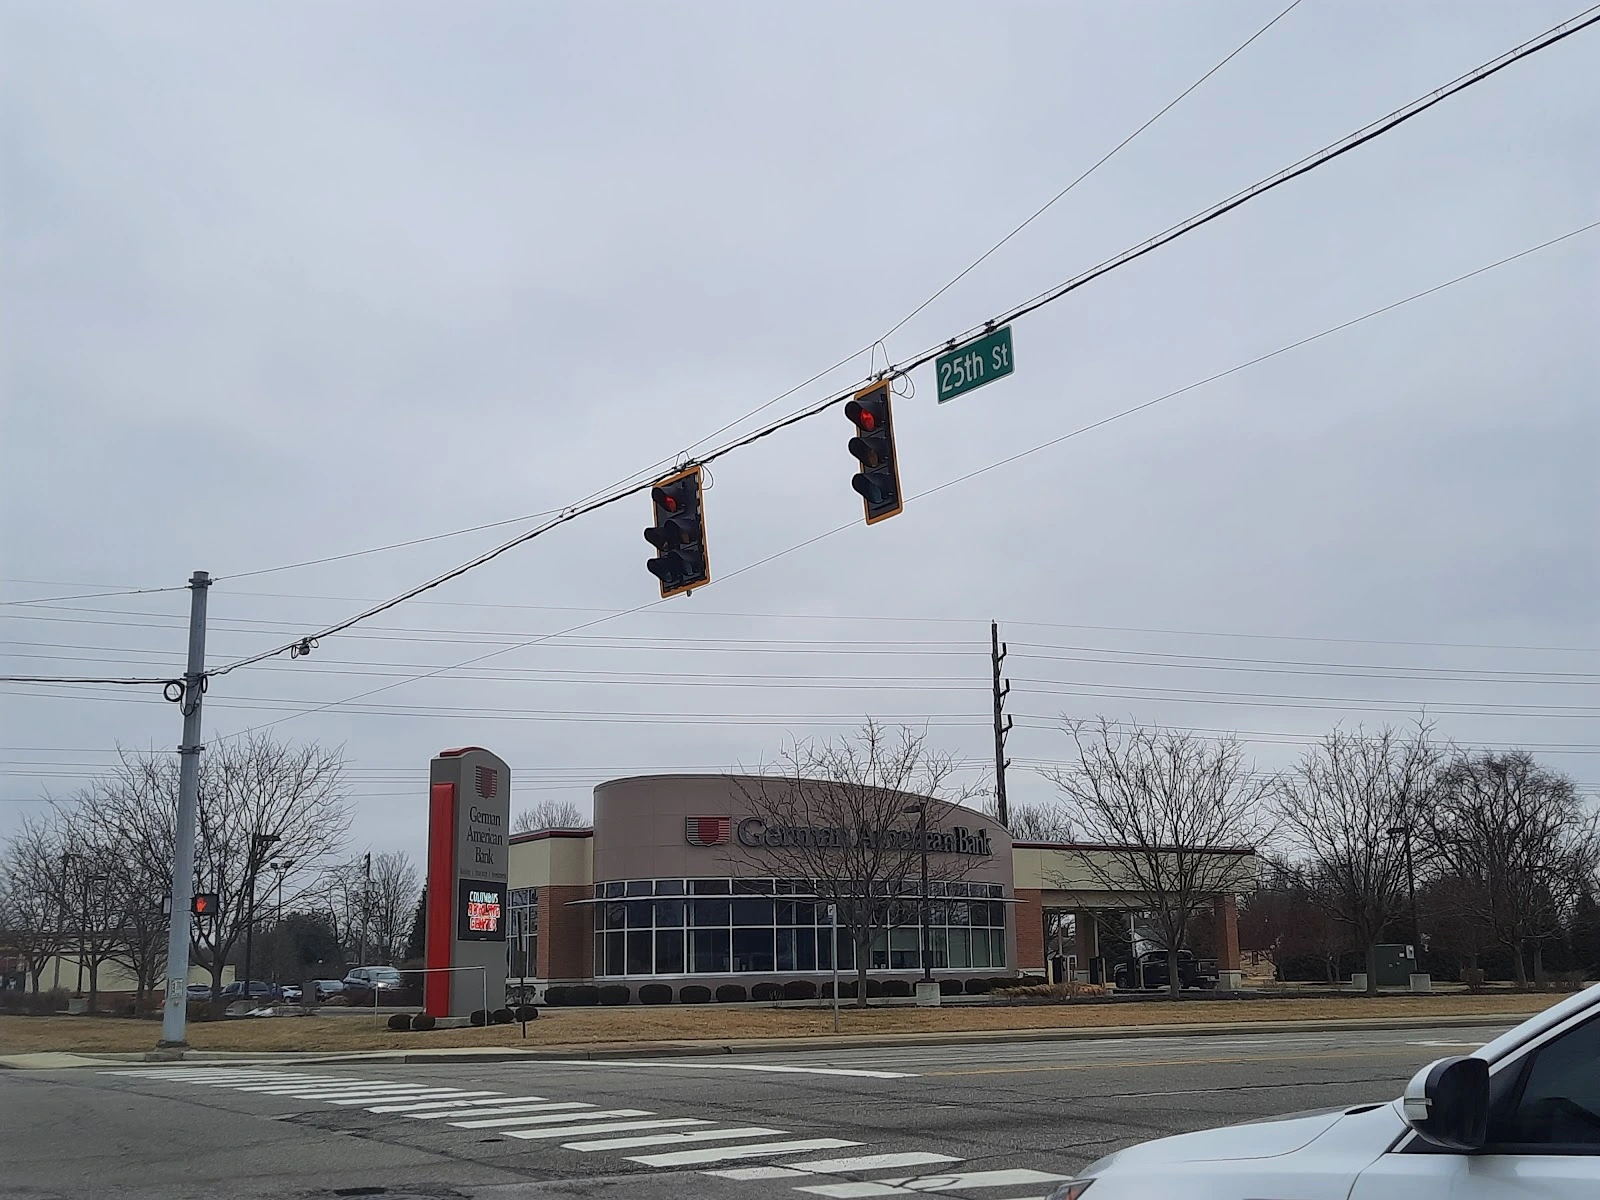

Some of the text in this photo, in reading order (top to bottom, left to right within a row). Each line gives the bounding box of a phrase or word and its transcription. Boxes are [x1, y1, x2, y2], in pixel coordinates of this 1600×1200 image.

[941, 343, 1008, 393] 25th St
[469, 806, 501, 826] German
[466, 826, 503, 846] American
[738, 816, 993, 856] German Amercan Bank
[475, 846, 494, 865] Bank
[469, 891, 499, 903] COLUMBUS
